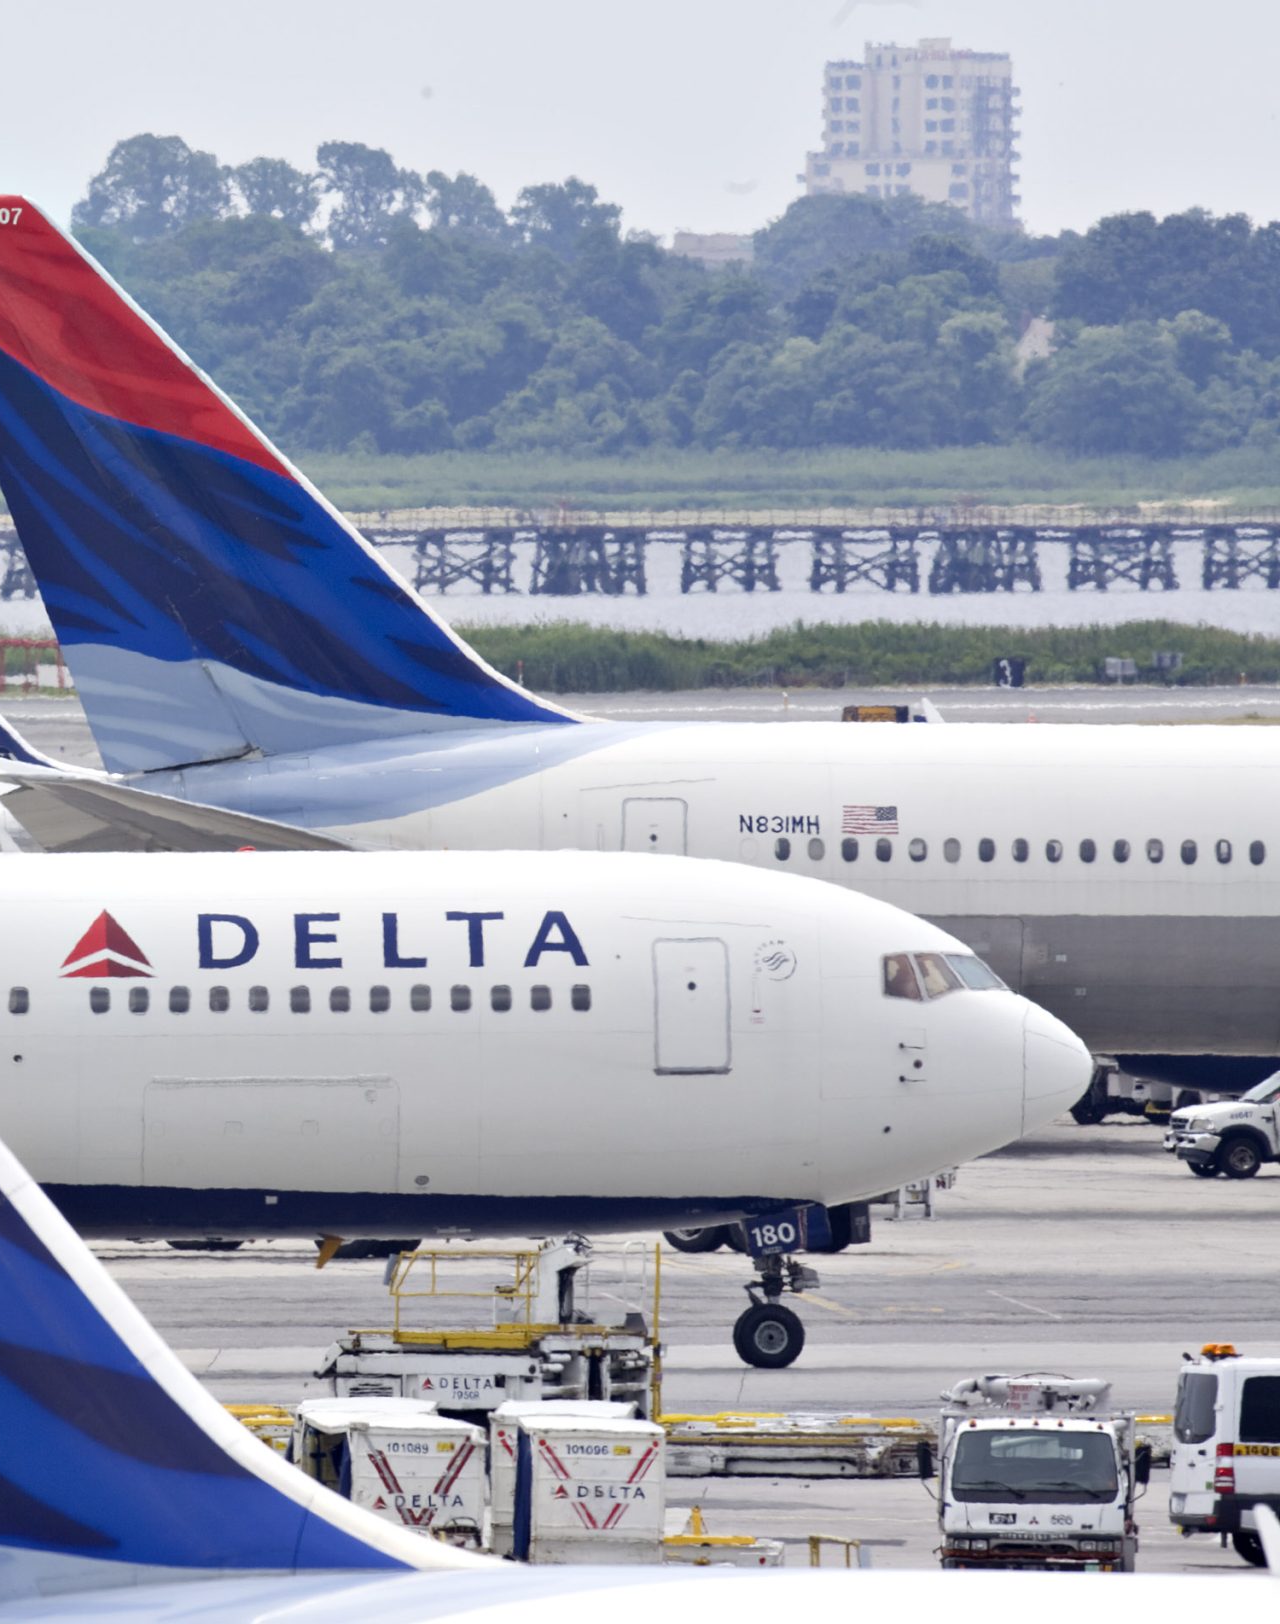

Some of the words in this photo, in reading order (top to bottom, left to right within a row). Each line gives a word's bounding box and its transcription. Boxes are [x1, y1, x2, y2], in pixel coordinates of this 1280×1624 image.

[197, 910, 591, 969] DELTA
[751, 1222, 796, 1248] 180
[439, 1377, 493, 1389] DELTA
[387, 1442, 429, 1454] 101089
[566, 1444, 609, 1455] 101096
[577, 1485, 646, 1499] DELTA
[395, 1494, 464, 1508] DELTA
